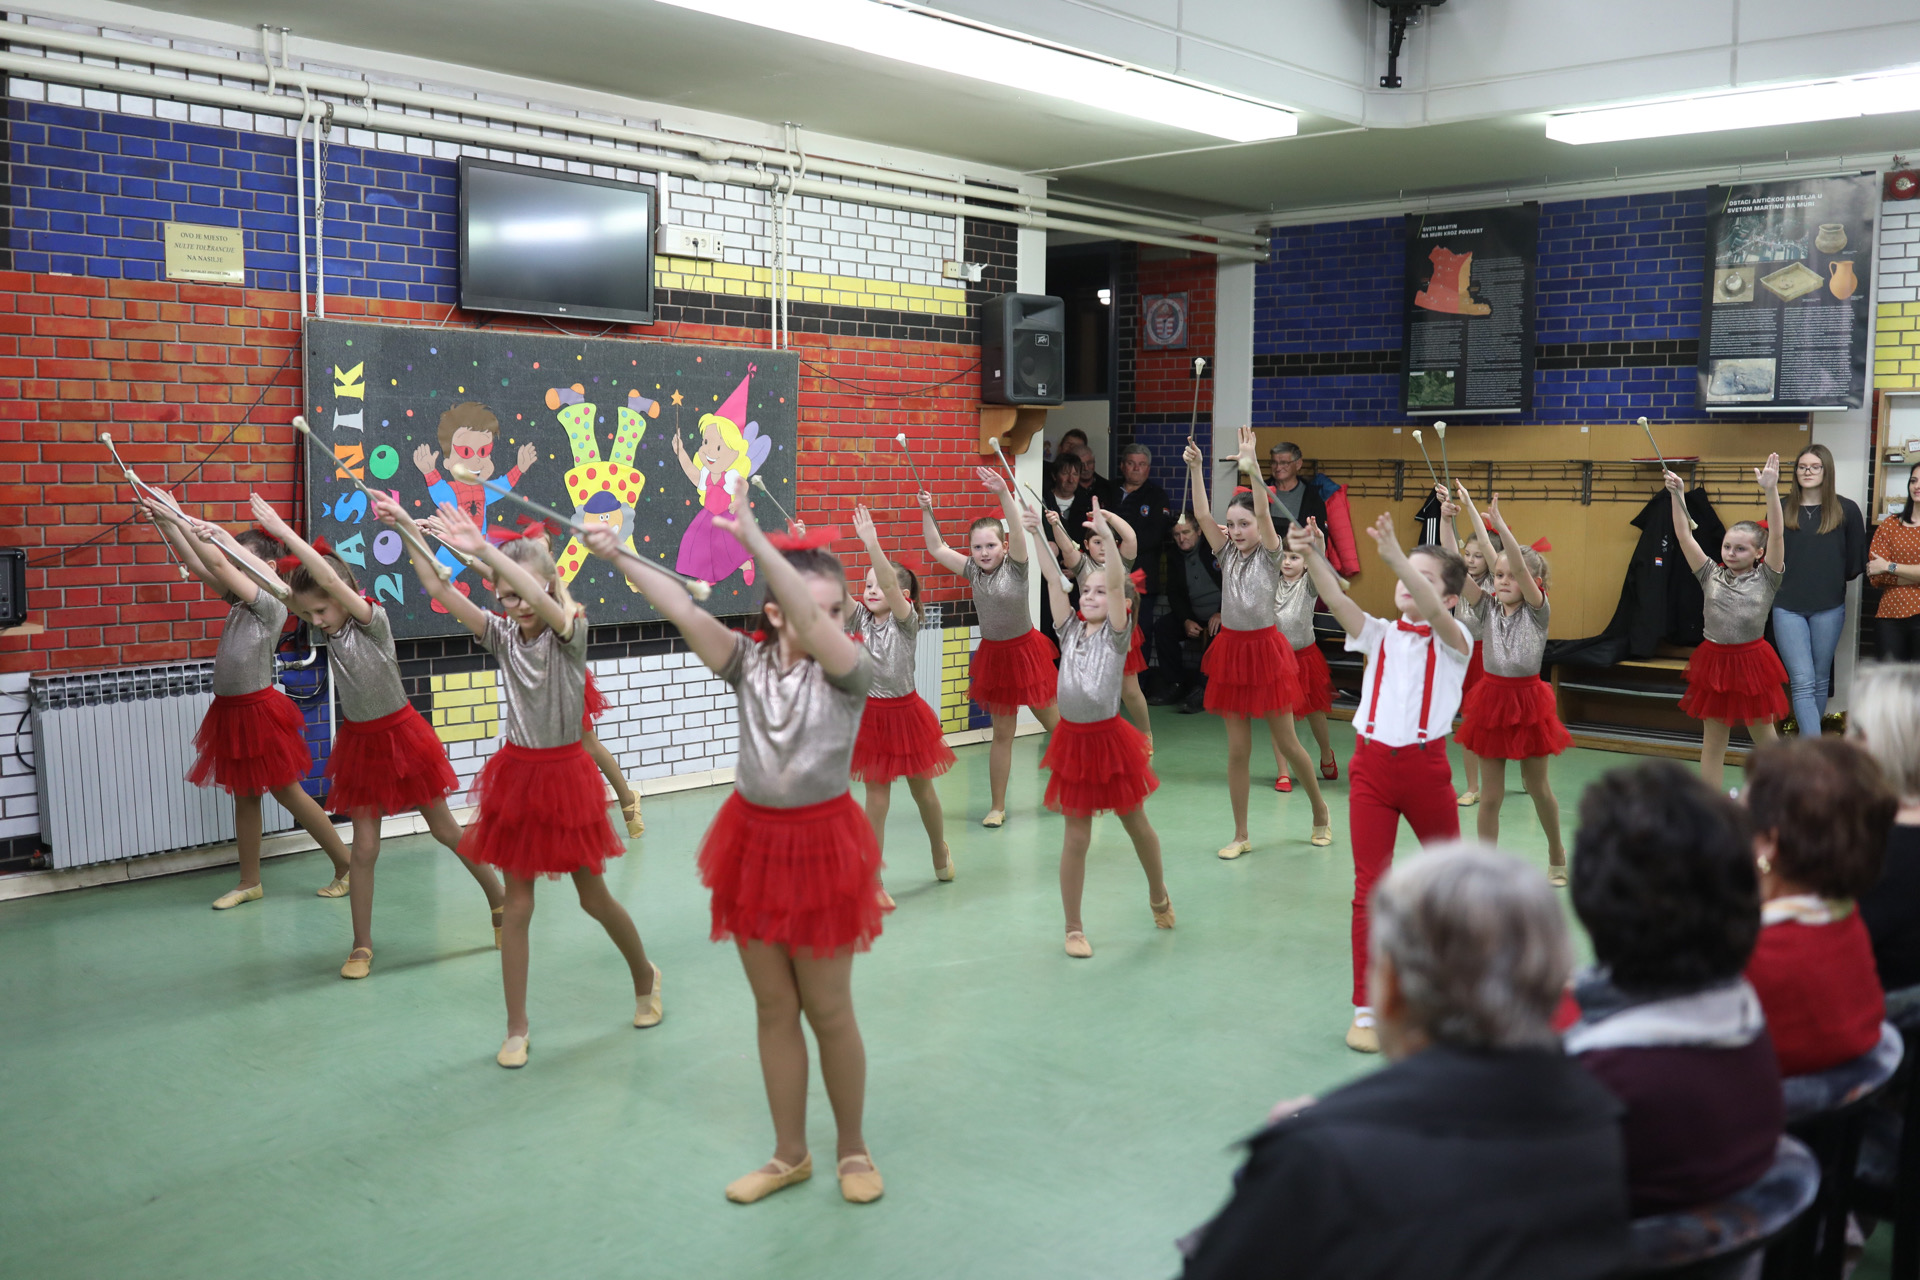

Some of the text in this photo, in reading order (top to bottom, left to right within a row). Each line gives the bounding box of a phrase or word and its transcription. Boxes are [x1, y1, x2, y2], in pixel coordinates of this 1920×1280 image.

[1752, 196, 1784, 204] ANTIČKOG
[196, 244, 235, 253] TOLERANCIJE
[322, 361, 367, 596] AŠNIK
